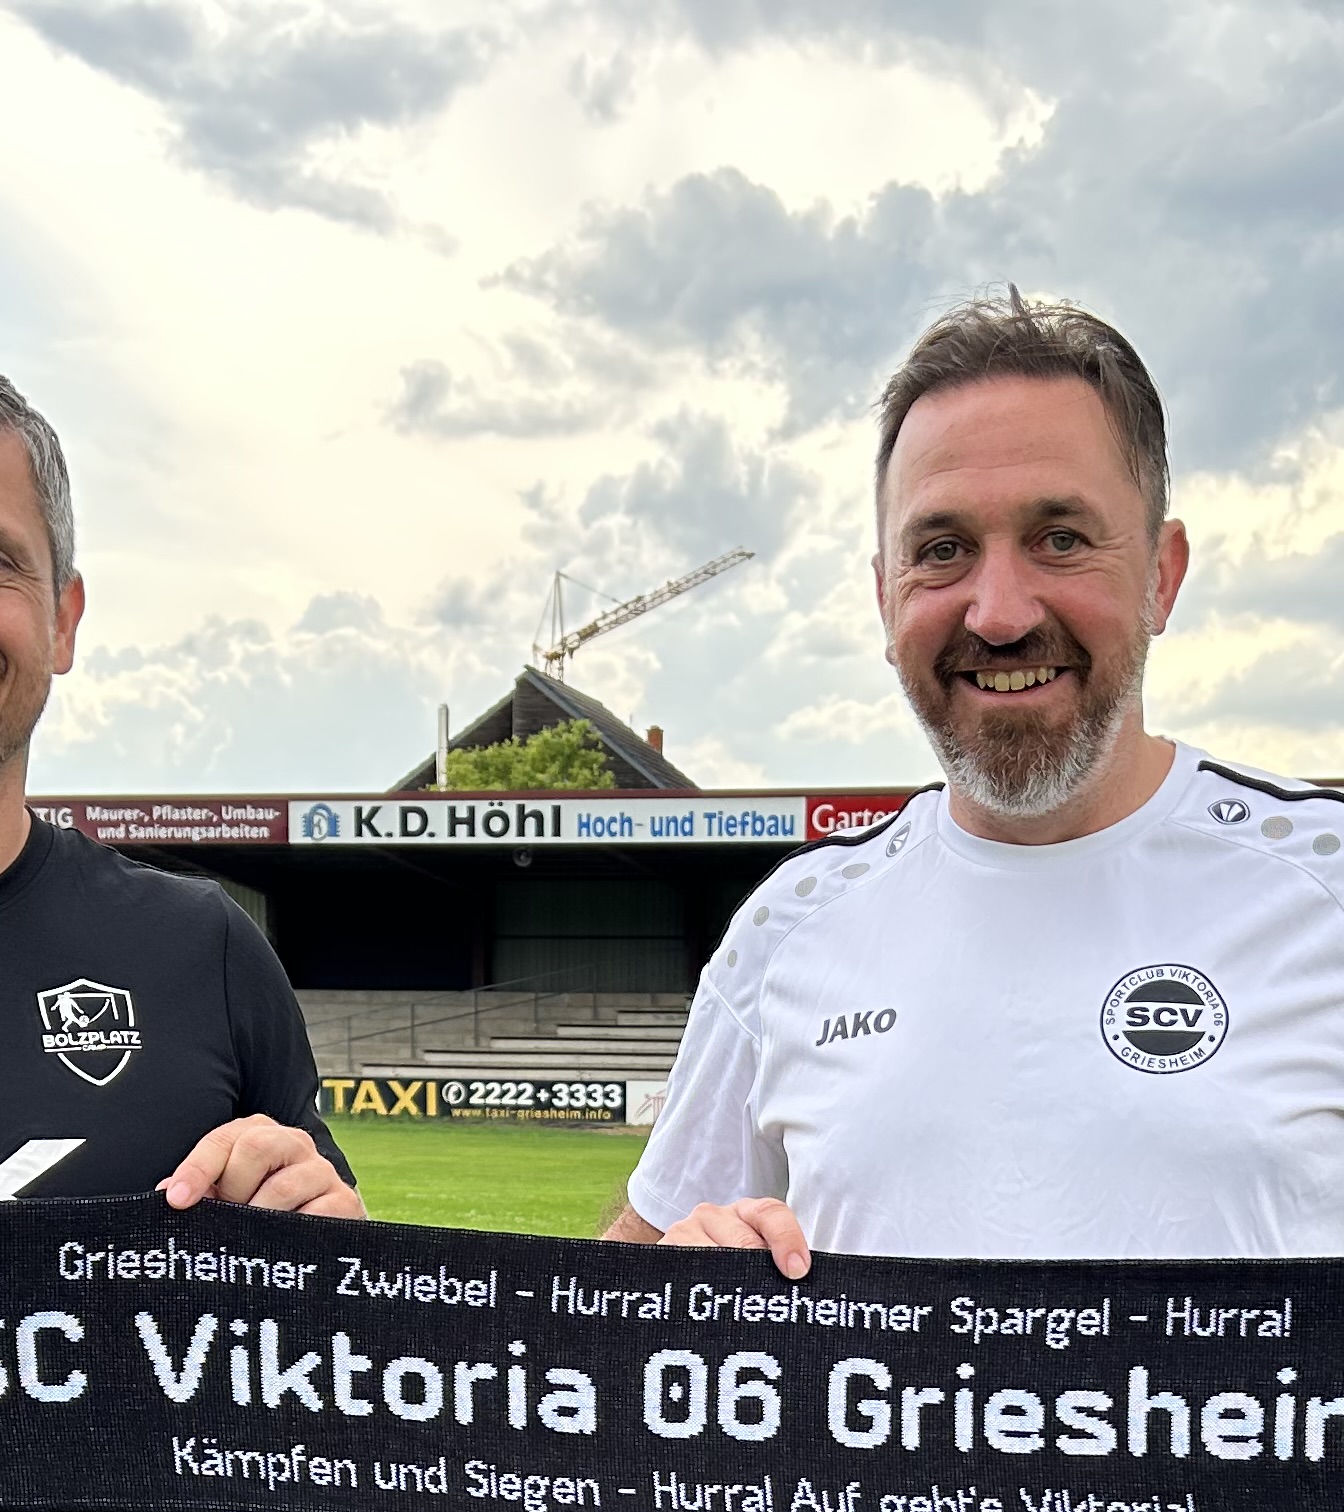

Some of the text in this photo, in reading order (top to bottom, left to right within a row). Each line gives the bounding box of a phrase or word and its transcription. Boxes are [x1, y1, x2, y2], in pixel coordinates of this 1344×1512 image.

[86, 804, 281, 823] Maurer-, Pflaster-, Umbau-
[447, 801, 561, 838] Höhl
[577, 811, 795, 838] Hoch- und Tiefbau
[812, 804, 896, 833] Garte
[97, 822, 270, 842] und Sanierungsarbeiten
[1106, 968, 1224, 1027] SPORTCLUB VIKTORIA 06
[816, 1008, 897, 1046] JAKO
[1125, 1006, 1204, 1028] SCV
[42, 1031, 142, 1048] BOLZPLATZ
[1121, 1046, 1207, 1069] GRIESHEIM
[322, 1080, 437, 1116] TAXI
[58, 1237, 317, 1291] Griesheimer
[336, 1257, 498, 1308] Zwiebel
[550, 1276, 672, 1321] Hurra!
[687, 1283, 933, 1335] Griesheimer
[950, 1296, 1111, 1349] Spargel
[1166, 1298, 1293, 1339] Hurra!
[135, 1311, 598, 1435] Viktoria
[642, 1349, 783, 1442] 06
[172, 1436, 358, 1491] Kämpfen
[374, 1456, 448, 1495] und
